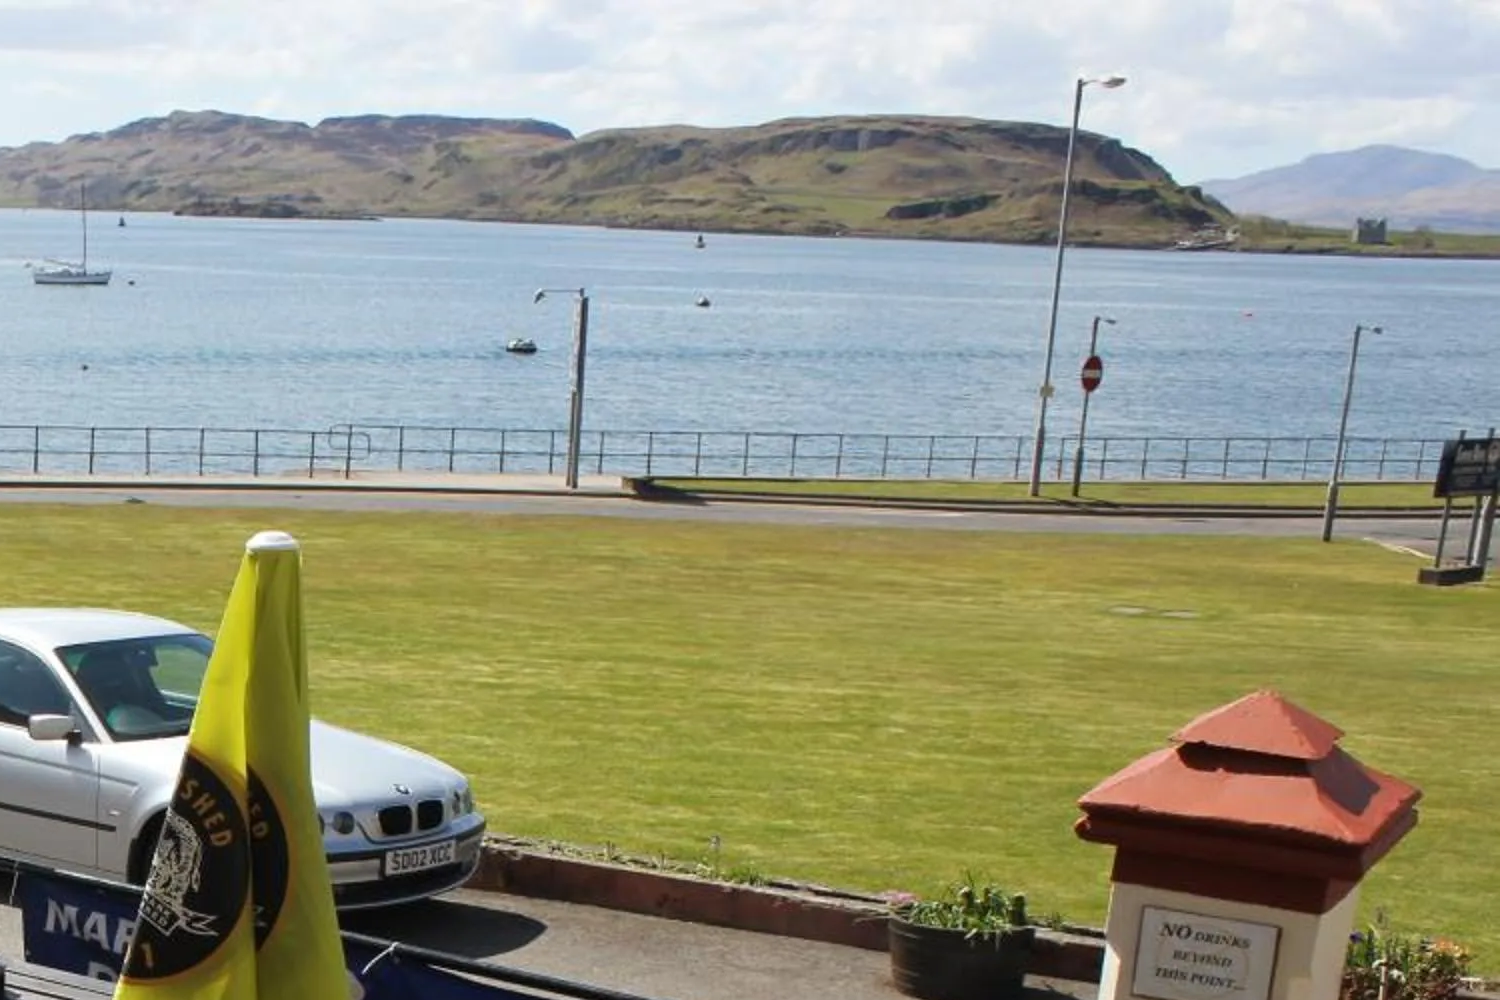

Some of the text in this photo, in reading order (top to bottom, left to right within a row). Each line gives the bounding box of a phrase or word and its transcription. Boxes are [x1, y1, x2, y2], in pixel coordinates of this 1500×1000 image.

[1160, 921, 1253, 949] NO DRINKS
[1172, 949, 1233, 969] BEYOND
[1155, 966, 1189, 982] THIS
